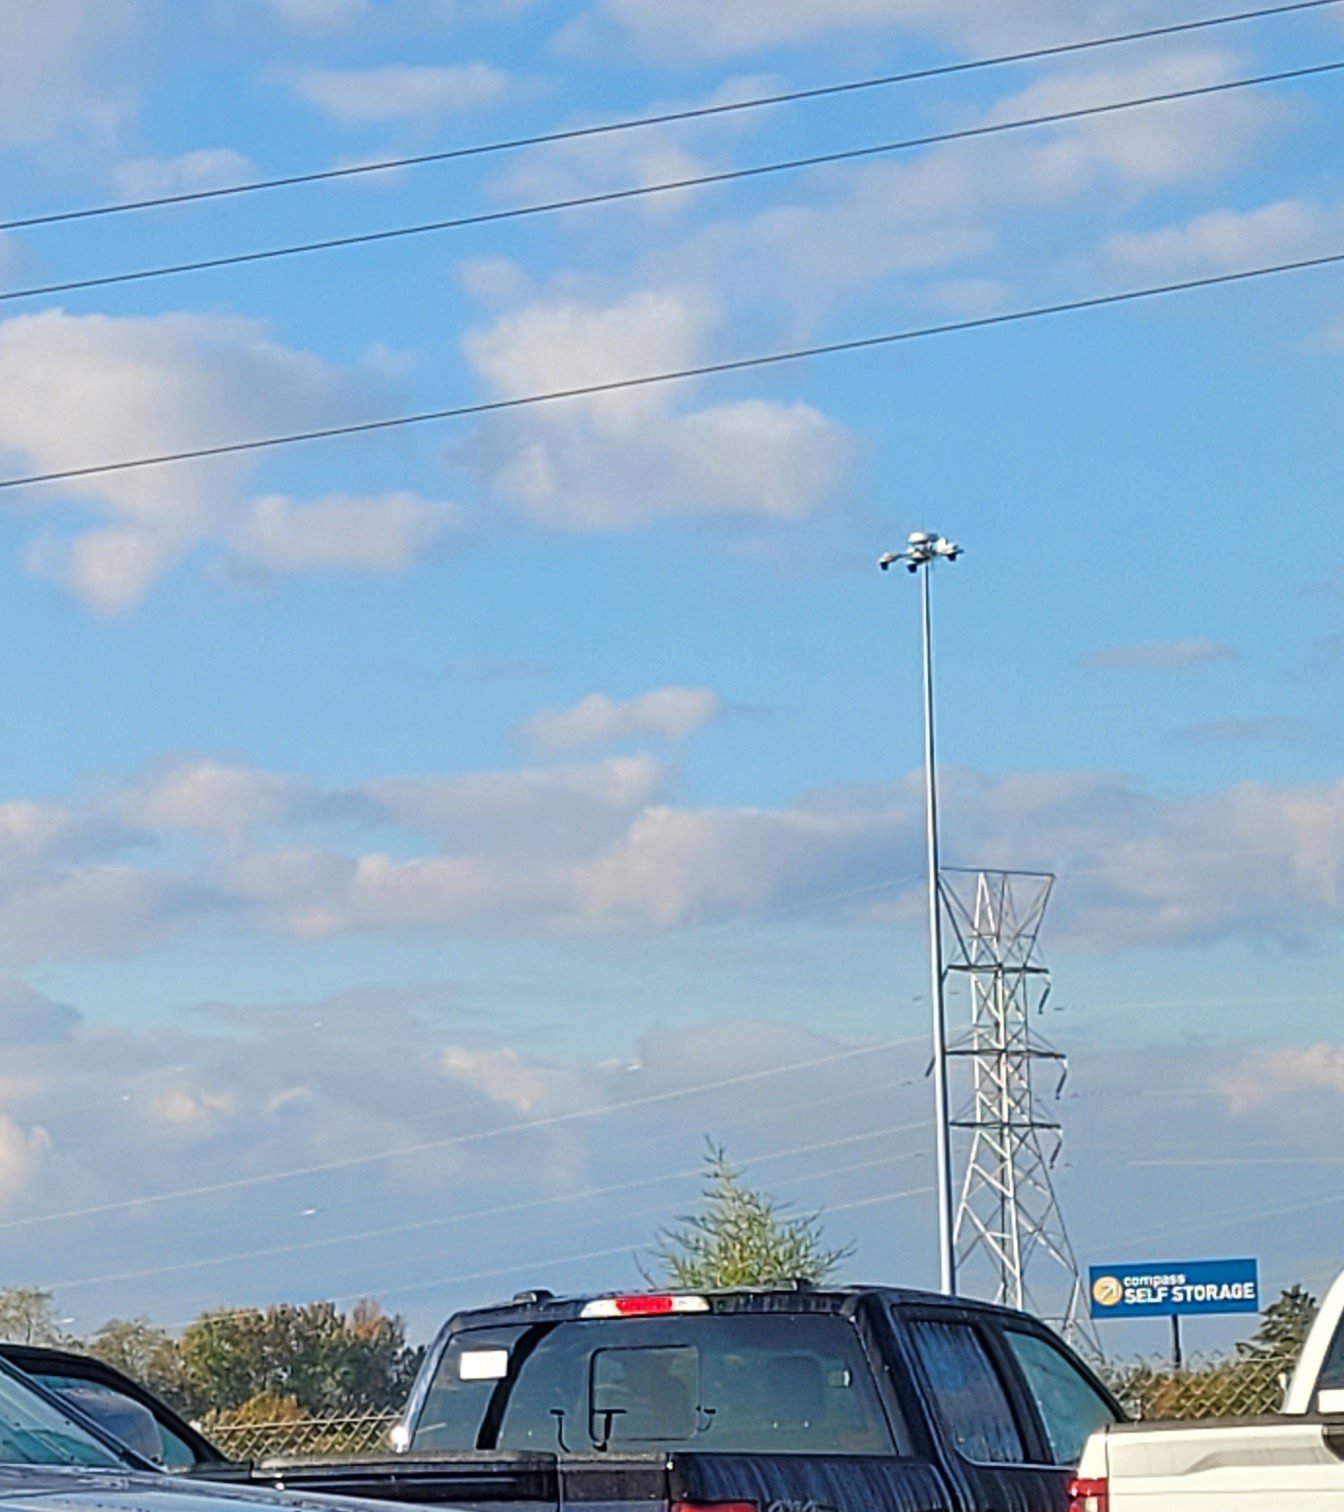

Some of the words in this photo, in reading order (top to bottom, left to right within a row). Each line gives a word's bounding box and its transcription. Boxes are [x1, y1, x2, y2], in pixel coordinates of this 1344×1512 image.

[1123, 1274, 1186, 1288] compass
[1123, 1286, 1169, 1304] SELF
[1172, 1282, 1256, 1302] STORAGE
